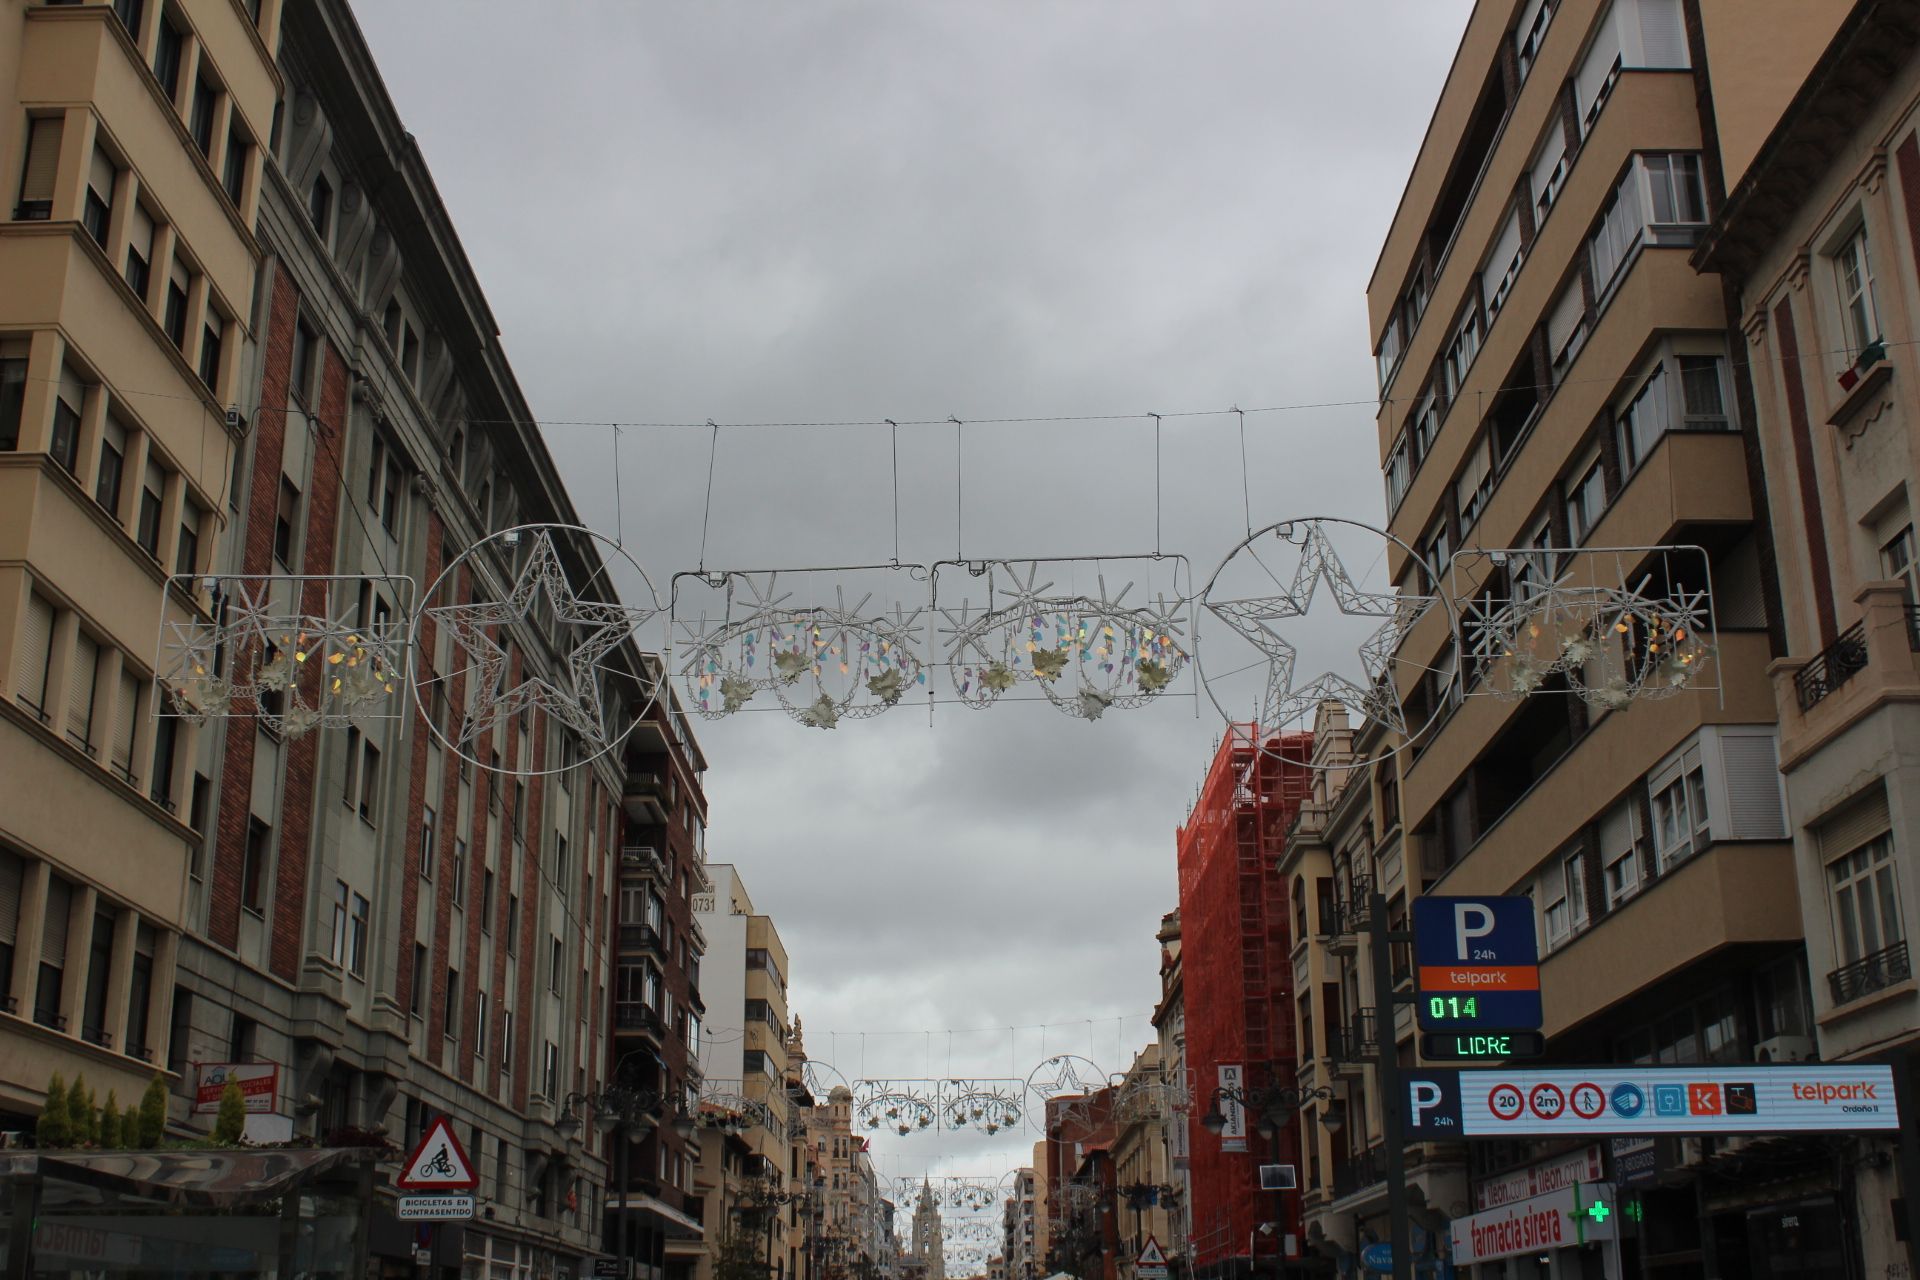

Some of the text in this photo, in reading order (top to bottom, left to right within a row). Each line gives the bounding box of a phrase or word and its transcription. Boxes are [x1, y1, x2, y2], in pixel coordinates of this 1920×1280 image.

[1454, 903, 1496, 960] P
[1473, 950, 1497, 960] 24h
[1450, 971, 1507, 986] telpark
[1430, 997, 1476, 1018] 014
[1792, 1081, 1878, 1104] telpark
[1409, 1081, 1442, 1127] P
[1499, 1096, 1516, 1107] 20
[1536, 1096, 1559, 1107] 2m
[1842, 1105, 1872, 1113] Ordoño
[1433, 1116, 1454, 1127] 24h
[405, 1199, 469, 1207] BICICLETAS EN
[401, 1208, 471, 1216] CONTRASENTIDO
[1471, 1205, 1562, 1257] farmacia sirera
